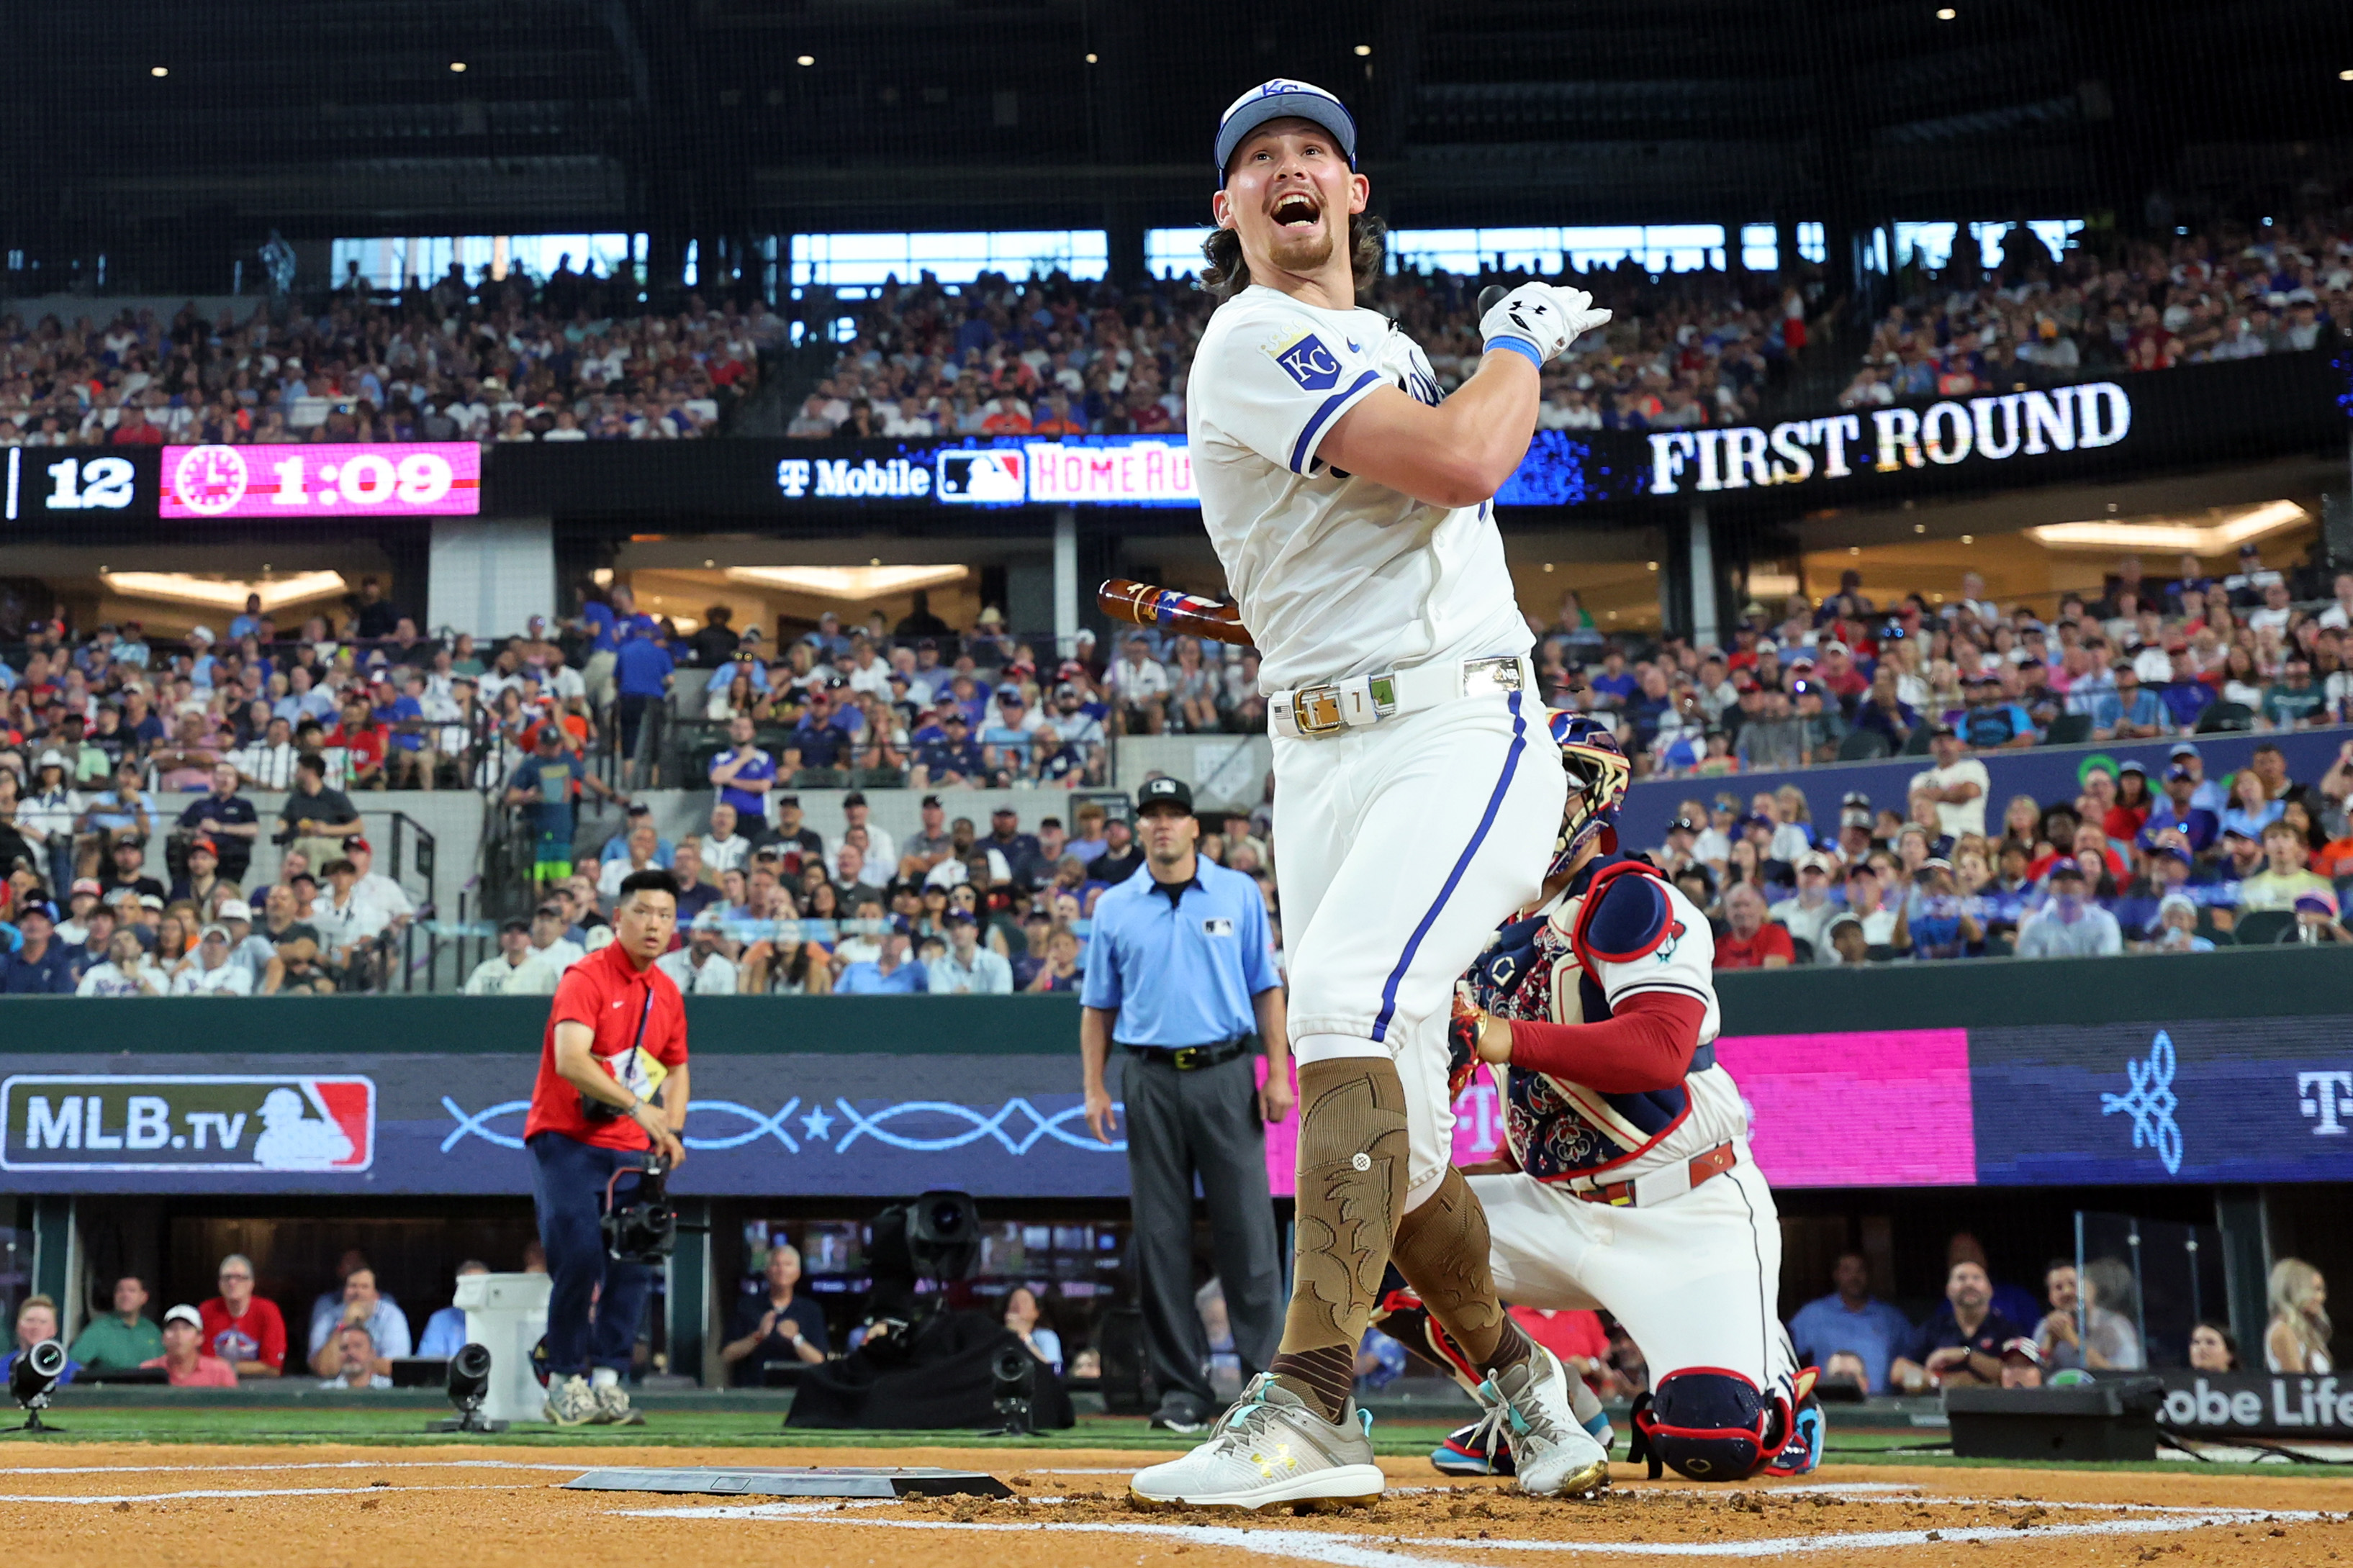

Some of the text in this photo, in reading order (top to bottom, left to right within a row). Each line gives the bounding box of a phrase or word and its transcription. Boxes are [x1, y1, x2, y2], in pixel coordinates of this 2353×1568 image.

[1283, 345, 1337, 383] KC
[1648, 381, 2131, 494] FIRST ROUND
[45, 456, 135, 509] 12
[272, 453, 453, 506] 1:09
[814, 458, 931, 497] Mobile
[25, 1095, 248, 1151] MLB.TV
[2155, 1377, 2263, 1426] obe
